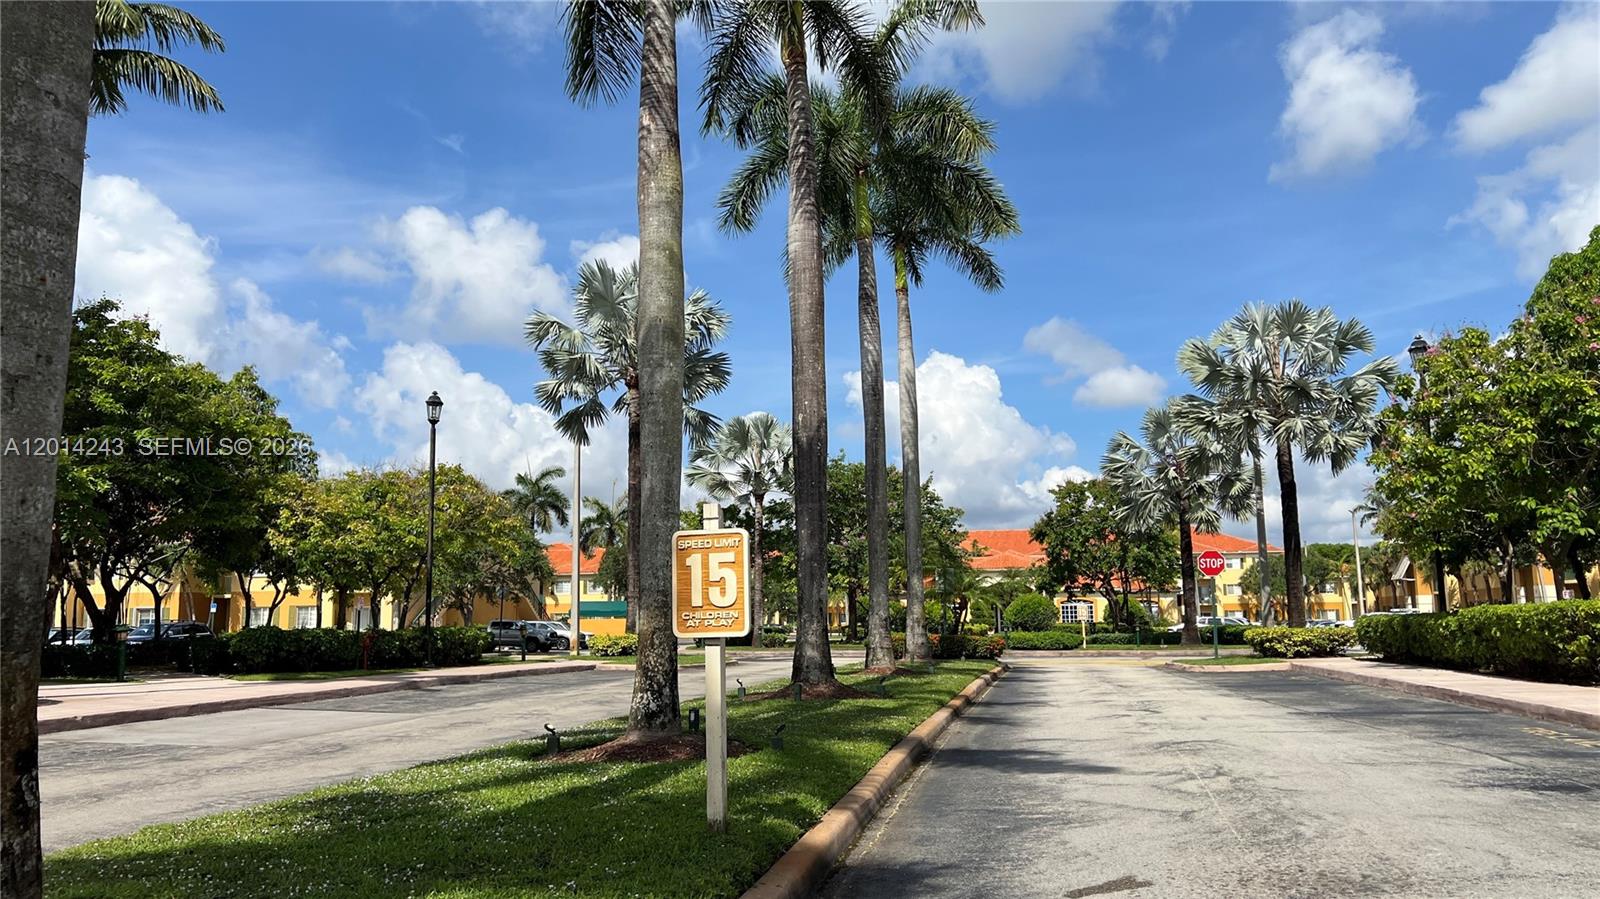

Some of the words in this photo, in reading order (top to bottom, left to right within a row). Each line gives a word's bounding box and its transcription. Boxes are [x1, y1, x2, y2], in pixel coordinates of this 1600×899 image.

[677, 539, 712, 549] SPEED
[714, 538, 740, 547] LIMIT
[1200, 558, 1223, 568] STOP
[685, 552, 737, 607] 15
[681, 611, 739, 619] CHILDREN
[686, 620, 700, 628] AT
[704, 619, 734, 627] PLAY
